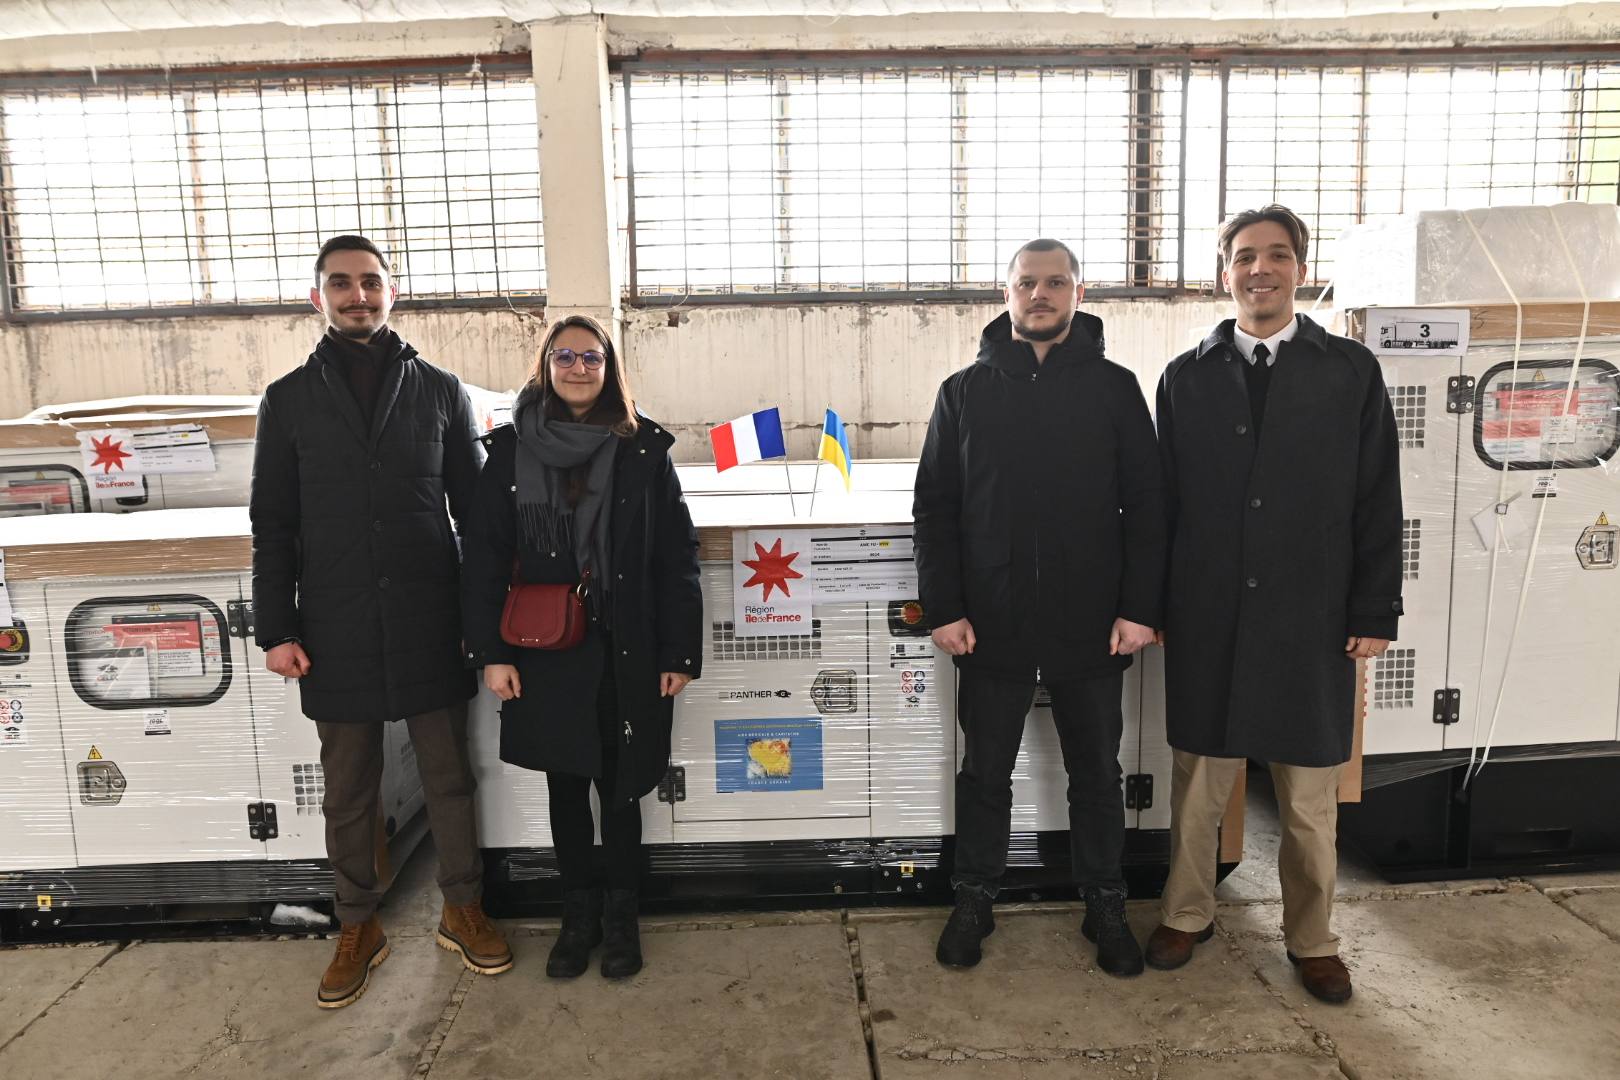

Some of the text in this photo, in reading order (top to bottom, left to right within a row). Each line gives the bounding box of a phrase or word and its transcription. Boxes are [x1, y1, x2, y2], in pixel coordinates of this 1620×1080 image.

[1420, 324, 1430, 338] 3
[745, 605, 775, 615] Région
[730, 690, 772, 699] PANTHER
